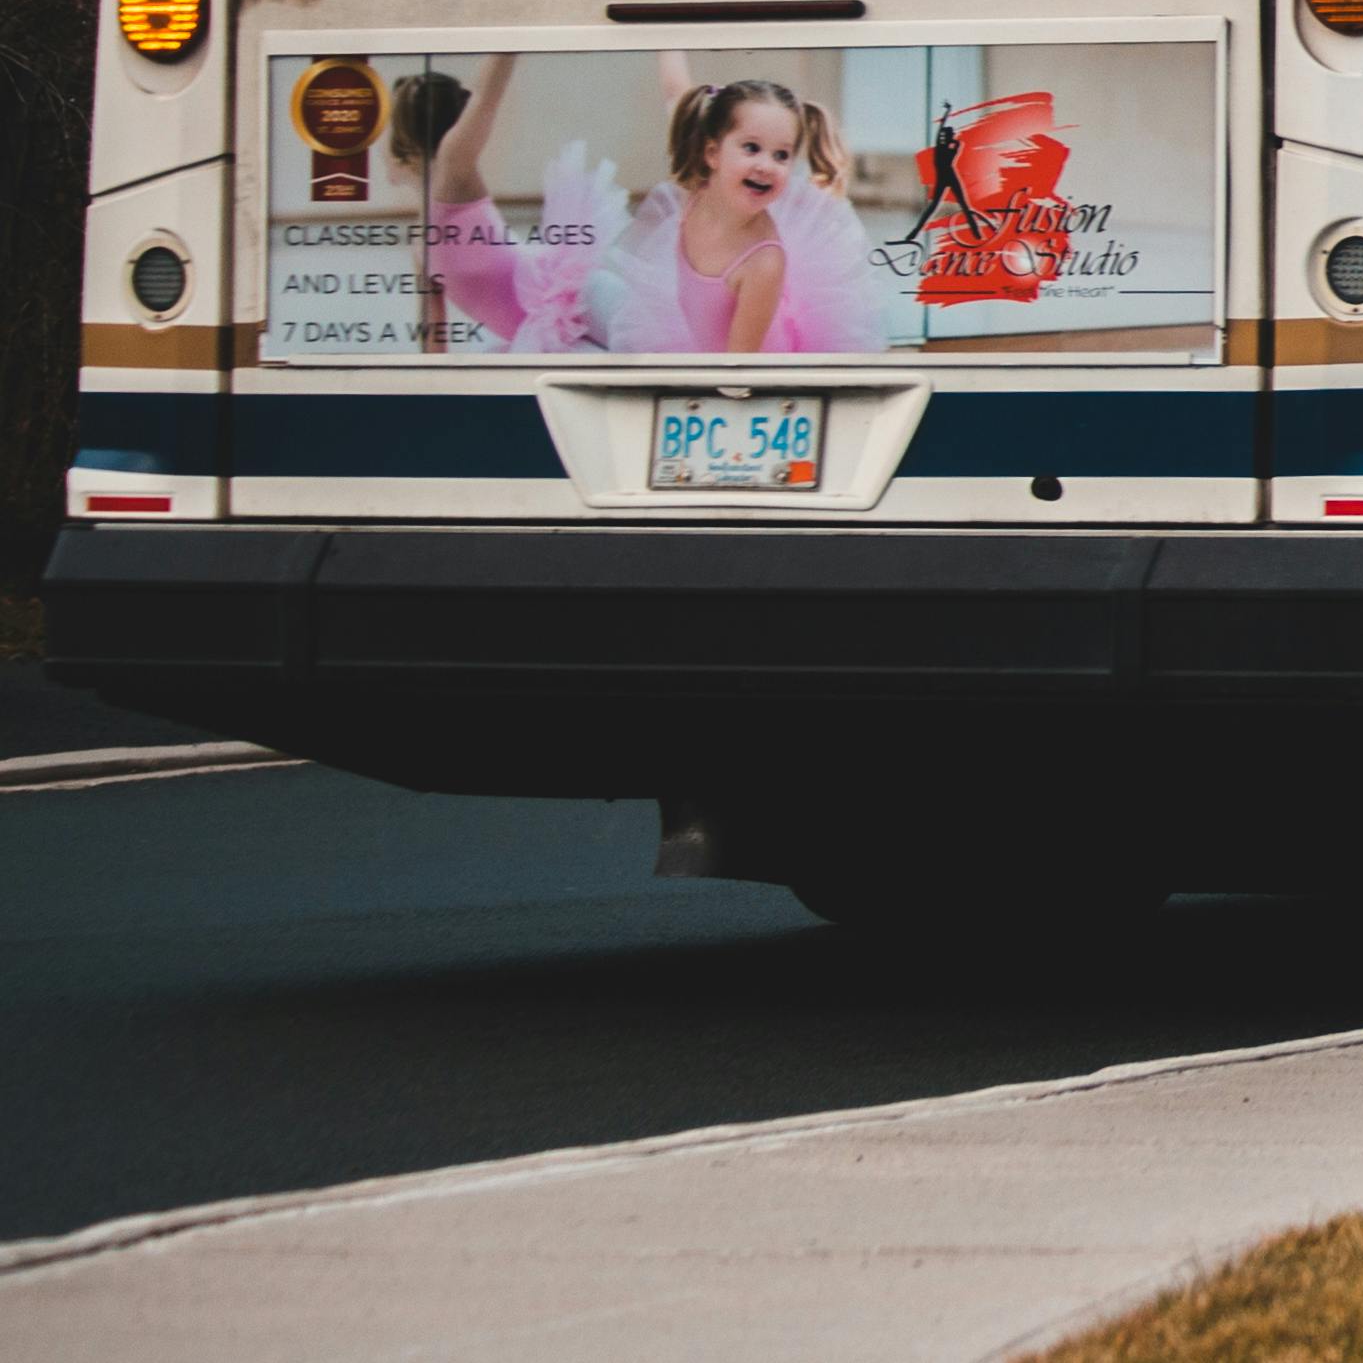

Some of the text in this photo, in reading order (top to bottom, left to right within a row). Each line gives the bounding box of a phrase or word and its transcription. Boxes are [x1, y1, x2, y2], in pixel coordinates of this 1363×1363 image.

[284, 224, 596, 246] CLASSES FOR ALL AGES
[1001, 237, 1140, 277] Studio
[282, 273, 446, 295] AND LEVELS
[282, 322, 485, 343] 7 DAYS A WEEK
[661, 415, 812, 458] BPC 548
